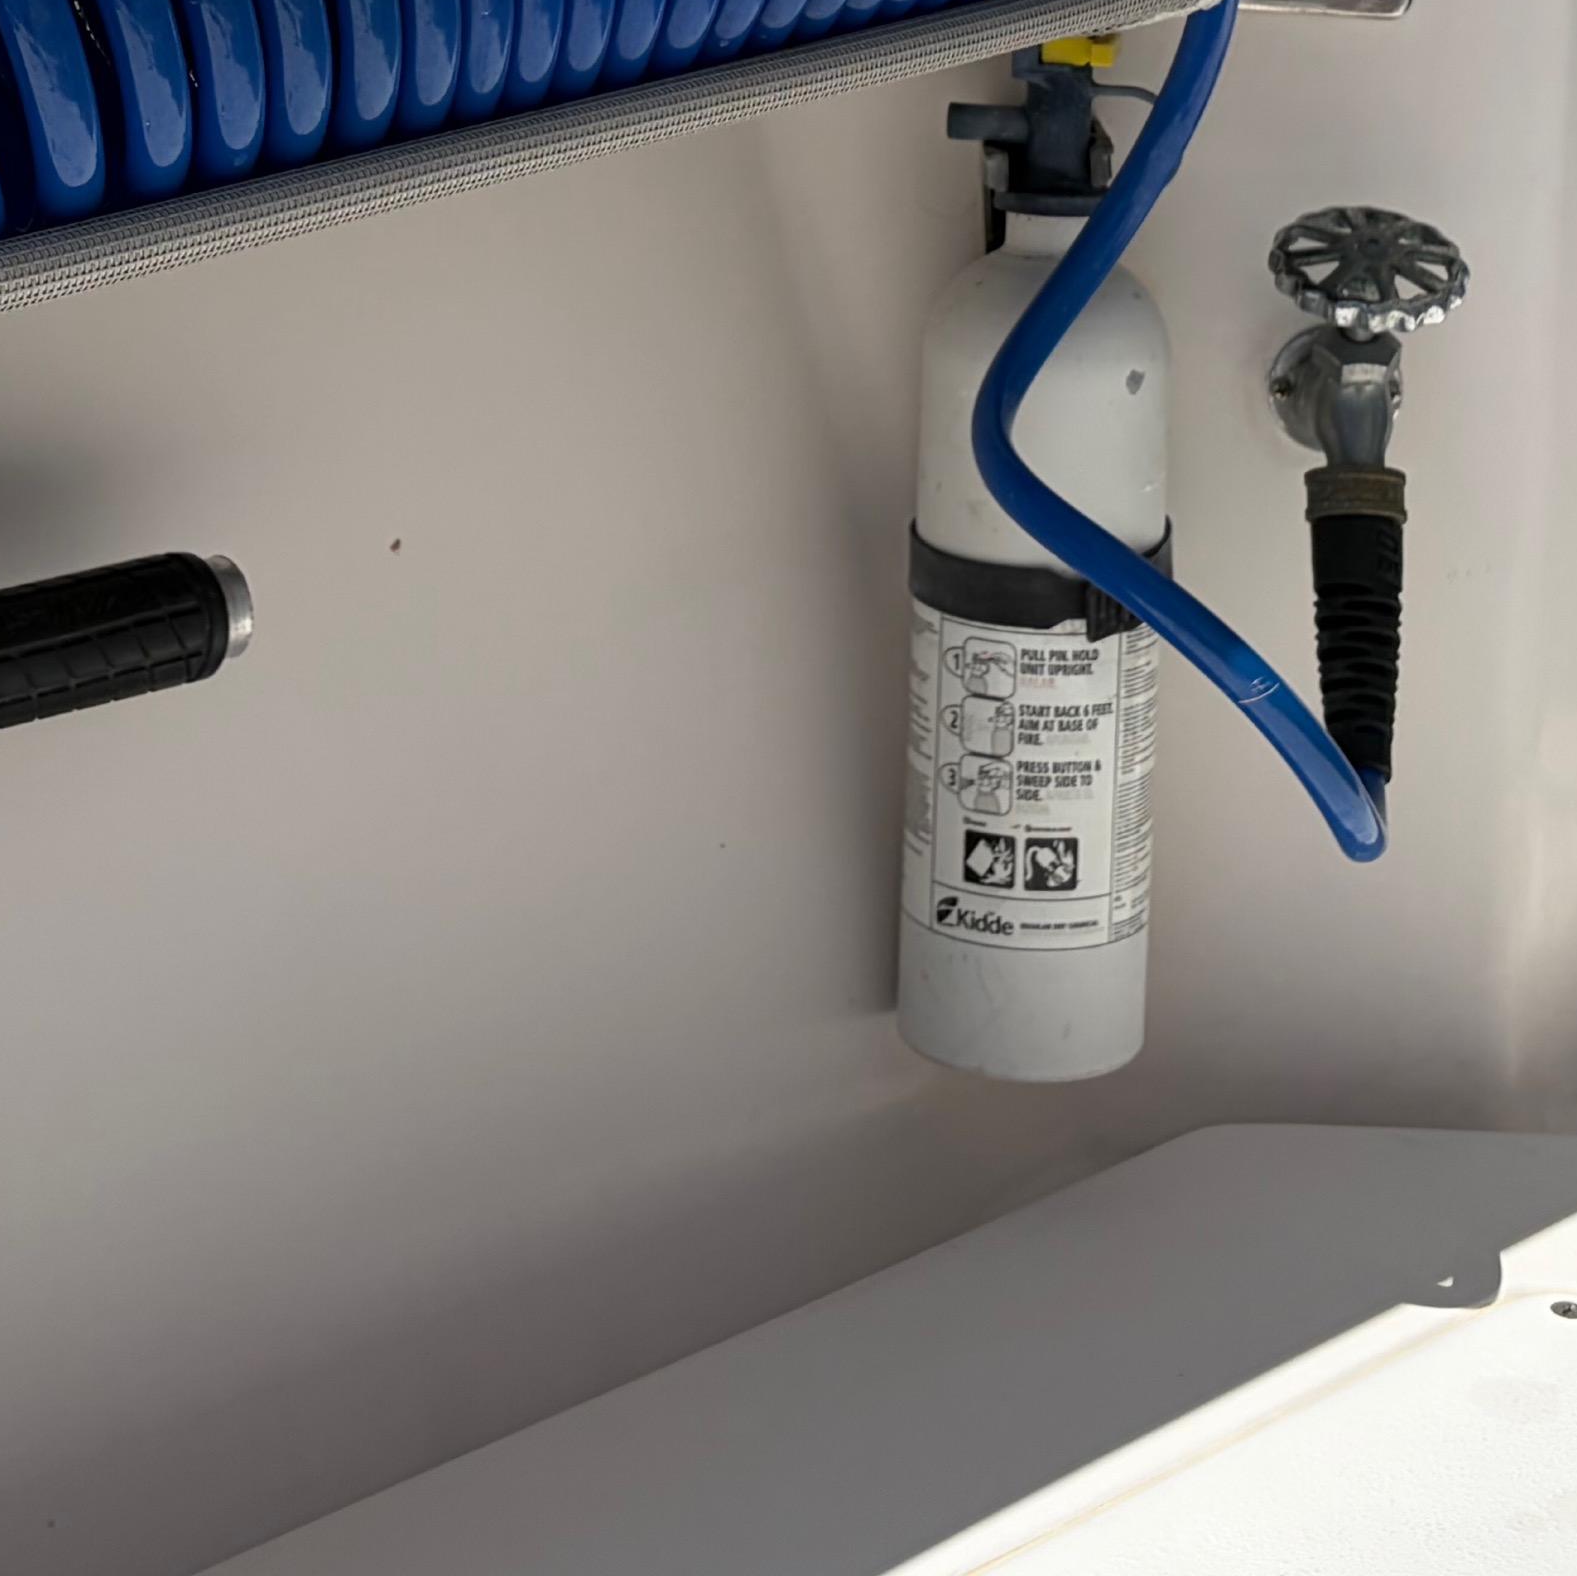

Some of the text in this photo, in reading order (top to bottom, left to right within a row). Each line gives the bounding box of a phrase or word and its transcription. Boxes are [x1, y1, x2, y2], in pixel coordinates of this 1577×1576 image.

[952, 652, 960, 671] 1
[1020, 648, 1046, 662] PULL
[1072, 648, 1100, 662] HOLD
[1018, 704, 1051, 717] START
[1053, 705, 1081, 718] BACK
[1083, 704, 1089, 717] 6
[950, 710, 958, 729] 2
[1017, 717, 1099, 732] AIM AT BASE OF
[1016, 760, 1050, 774] PRESS
[1052, 760, 1092, 774] BUTTON
[948, 767, 956, 787] 3
[1016, 774, 1093, 788] SWEEP SIDE TO
[1015, 788, 1043, 801] SIDE.
[956, 908, 1014, 936] Kidde
